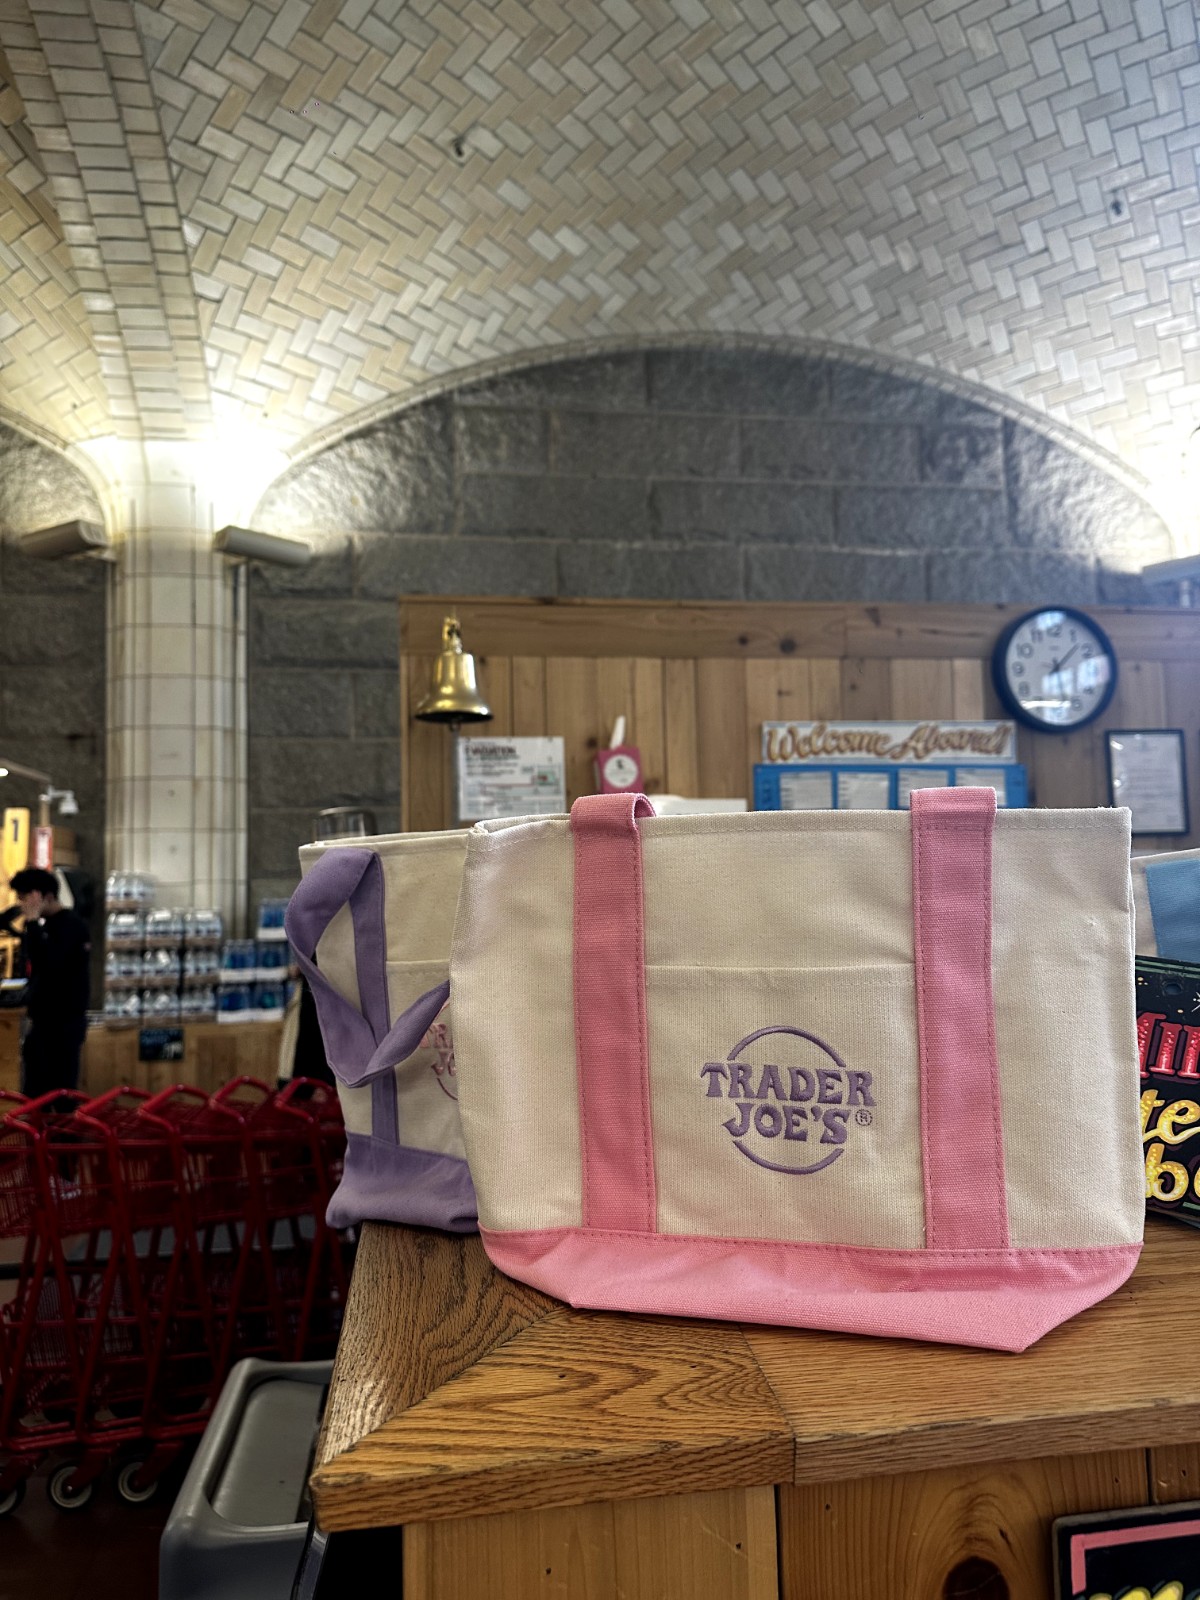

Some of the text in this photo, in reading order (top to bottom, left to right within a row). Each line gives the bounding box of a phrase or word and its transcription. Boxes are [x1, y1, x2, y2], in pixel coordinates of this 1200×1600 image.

[1046, 624, 1062, 637] 12
[1069, 628, 1077, 643] 1
[1016, 642, 1034, 659] 10
[1080, 642, 1093, 658] 2
[766, 723, 890, 762] Welcome
[12, 818, 20, 842] 1
[700, 1062, 877, 1106] TRADER
